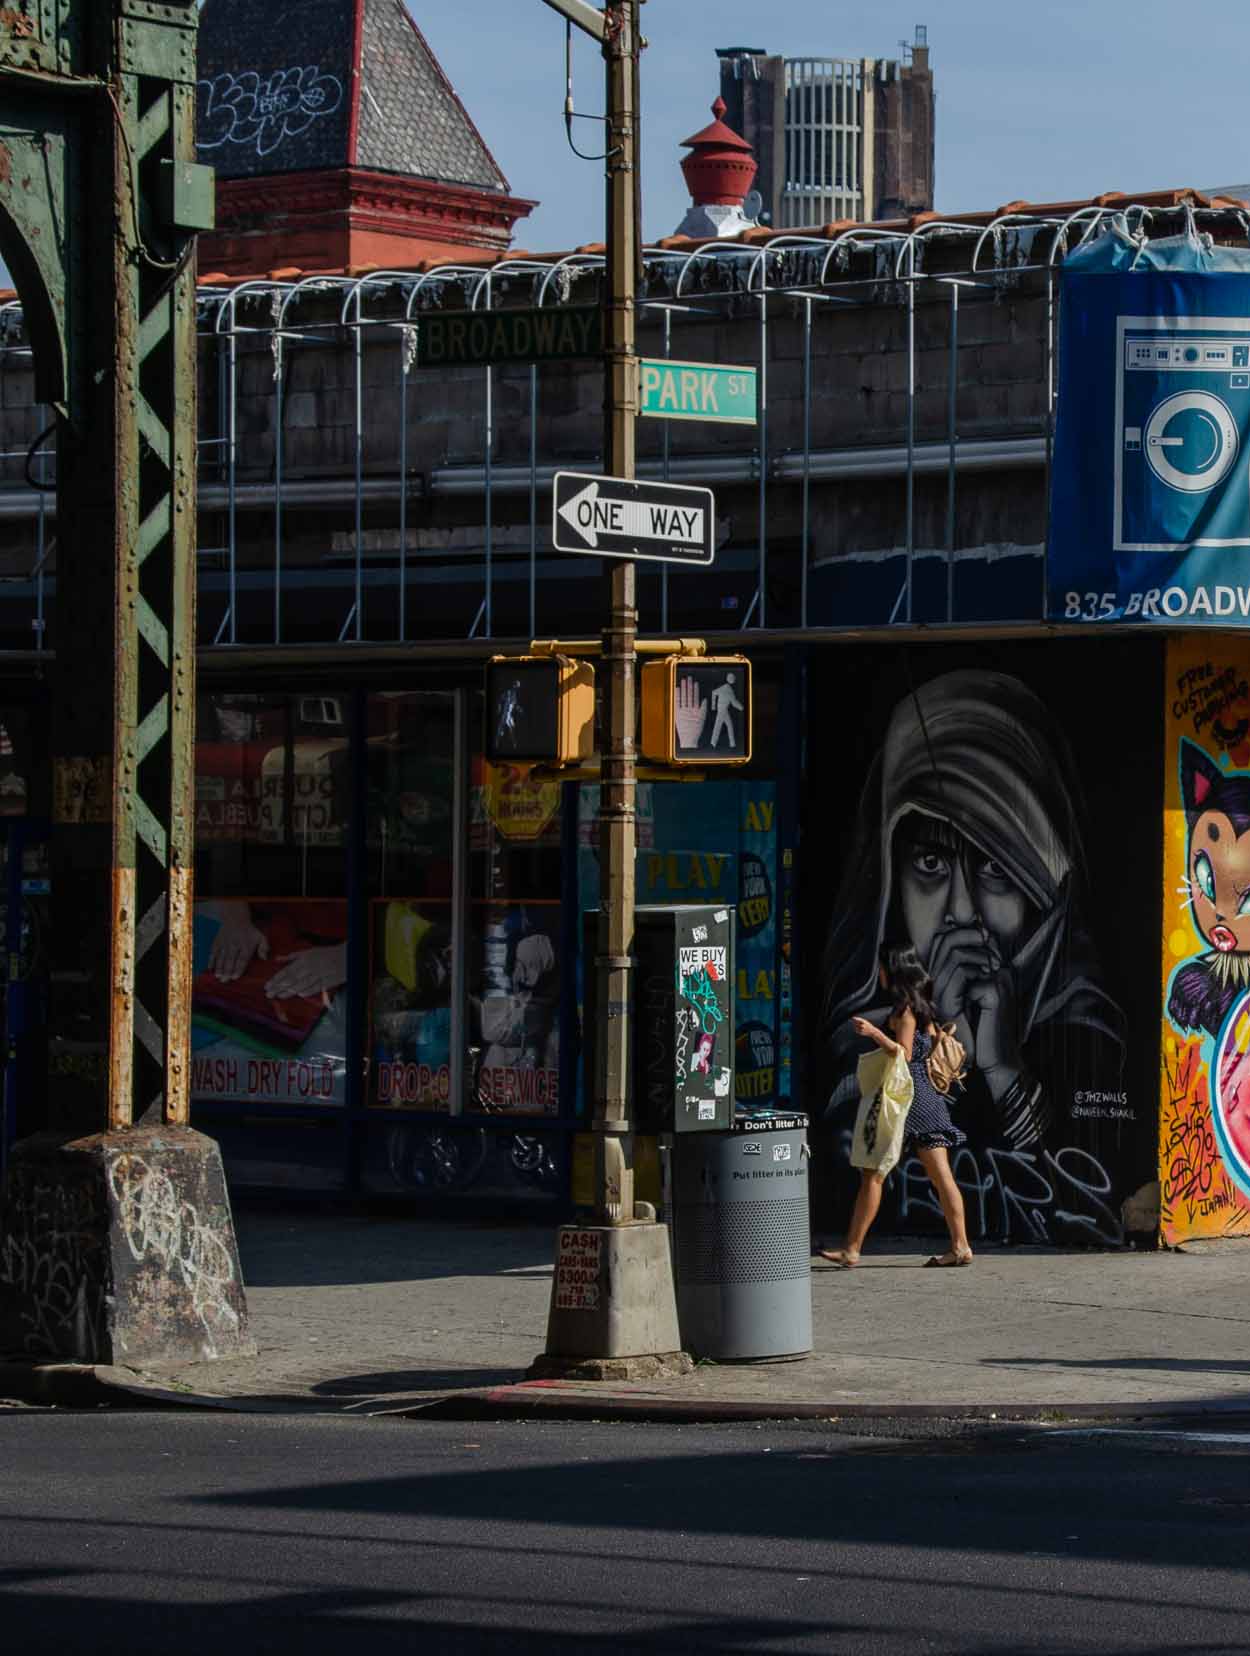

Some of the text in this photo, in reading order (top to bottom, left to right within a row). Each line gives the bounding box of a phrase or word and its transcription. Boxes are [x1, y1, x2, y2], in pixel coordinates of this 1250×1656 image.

[427, 312, 593, 358] BROADWAY
[642, 366, 749, 413] PARK ST
[577, 499, 699, 538] ONE WAY
[1064, 592, 1117, 621] 835
[646, 852, 725, 890] PLAY
[681, 949, 724, 962] WE BUY
[248, 1061, 288, 1096] DRY
[288, 1060, 334, 1098] FOLD
[480, 1066, 561, 1106] SERVICE
[744, 1121, 773, 1131] Don't
[775, 1118, 795, 1128] litter
[733, 1171, 750, 1182] Put
[752, 1168, 773, 1180] litter
[561, 1233, 598, 1249] CASH
